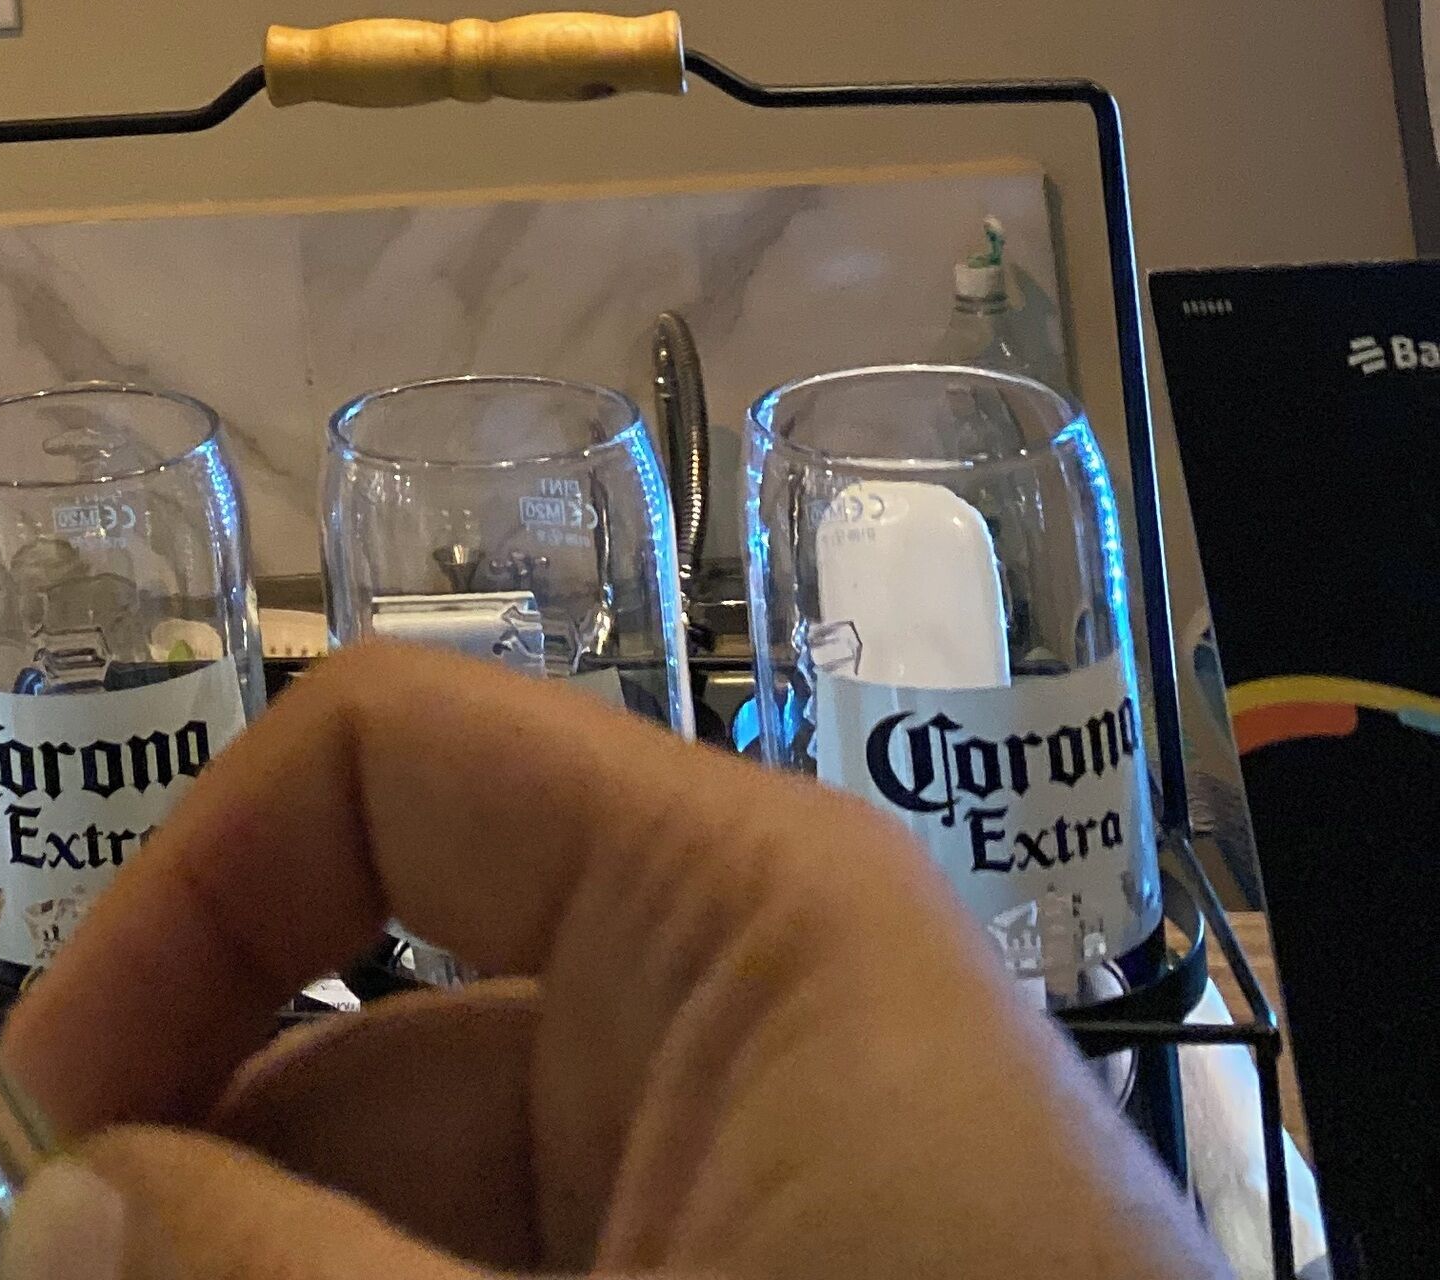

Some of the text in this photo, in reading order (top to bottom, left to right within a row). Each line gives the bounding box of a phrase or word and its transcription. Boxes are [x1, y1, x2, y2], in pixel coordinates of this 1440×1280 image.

[866, 697, 1138, 827] Corona
[5, 804, 157, 870] Extr
[963, 806, 1123, 875] Extra
